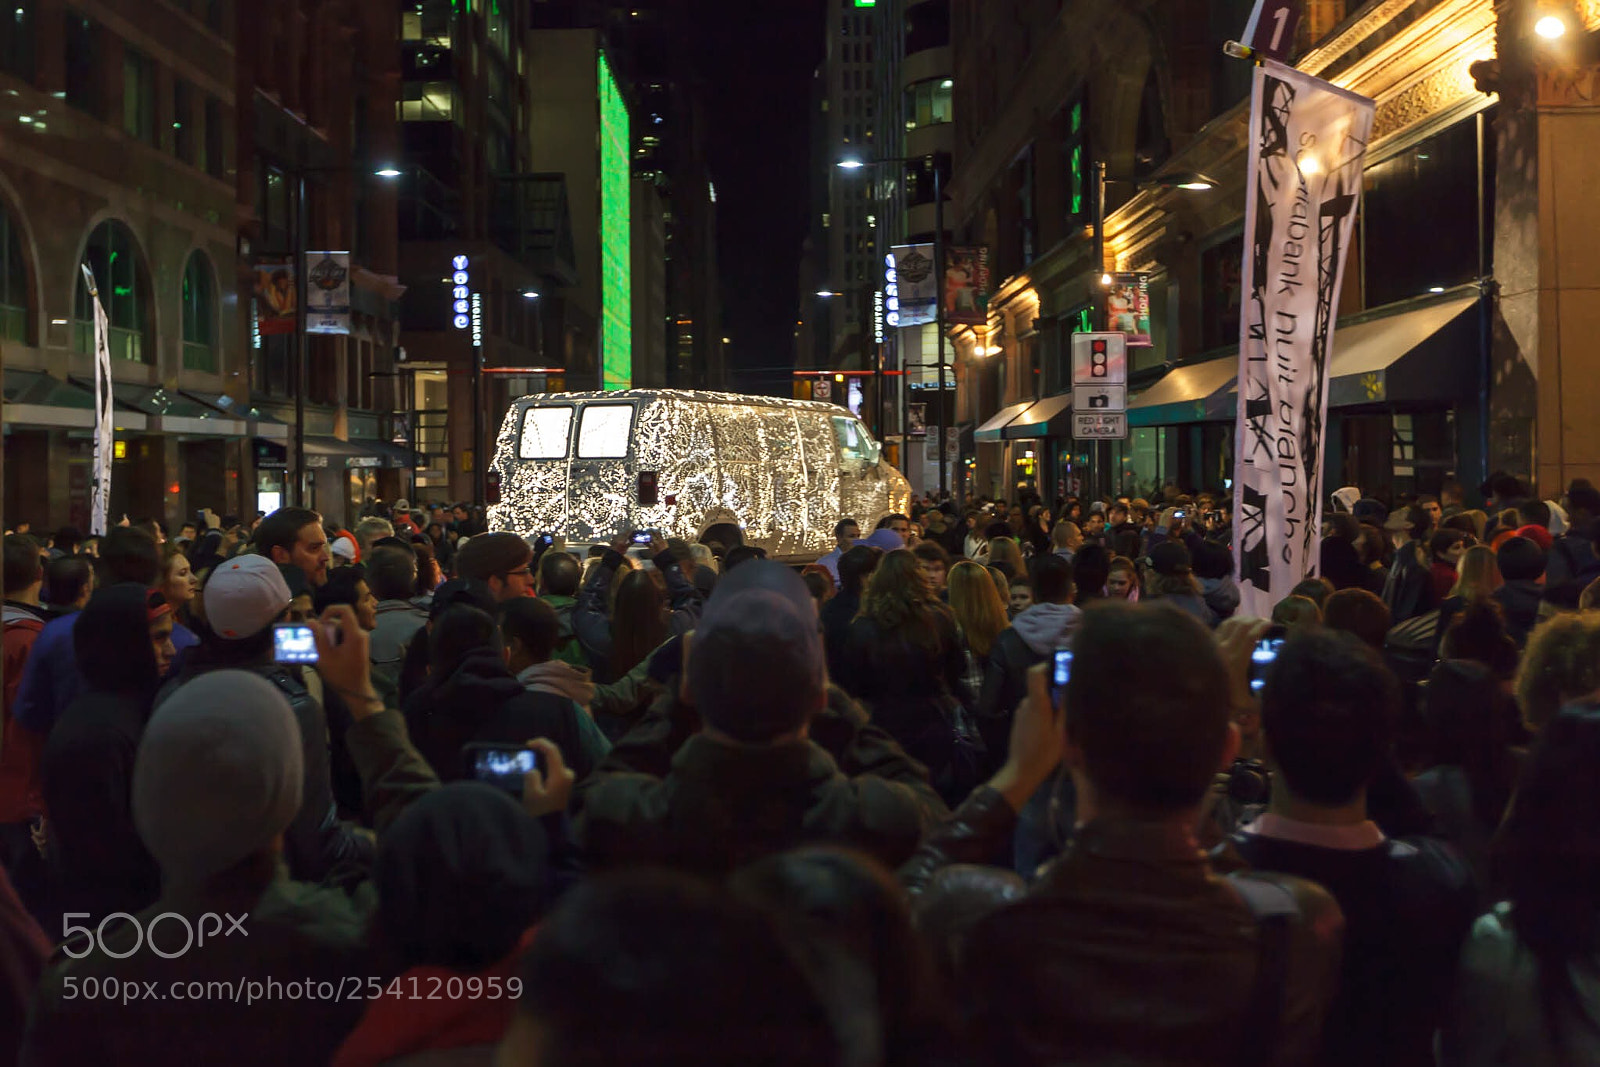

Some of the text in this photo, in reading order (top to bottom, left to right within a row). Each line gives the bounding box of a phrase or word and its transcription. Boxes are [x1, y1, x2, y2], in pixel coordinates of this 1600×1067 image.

[1269, 7, 1290, 51] 1
[1277, 131, 1317, 297] stiabank
[472, 292, 481, 347] DOWNTOWN
[874, 291, 883, 343] DOWNTOWN
[1139, 275, 1149, 320] SHOPPING
[1276, 310, 1298, 384] nuit
[1078, 416, 1120, 425] RED LIGHT
[1082, 426, 1116, 435] CAMERA
